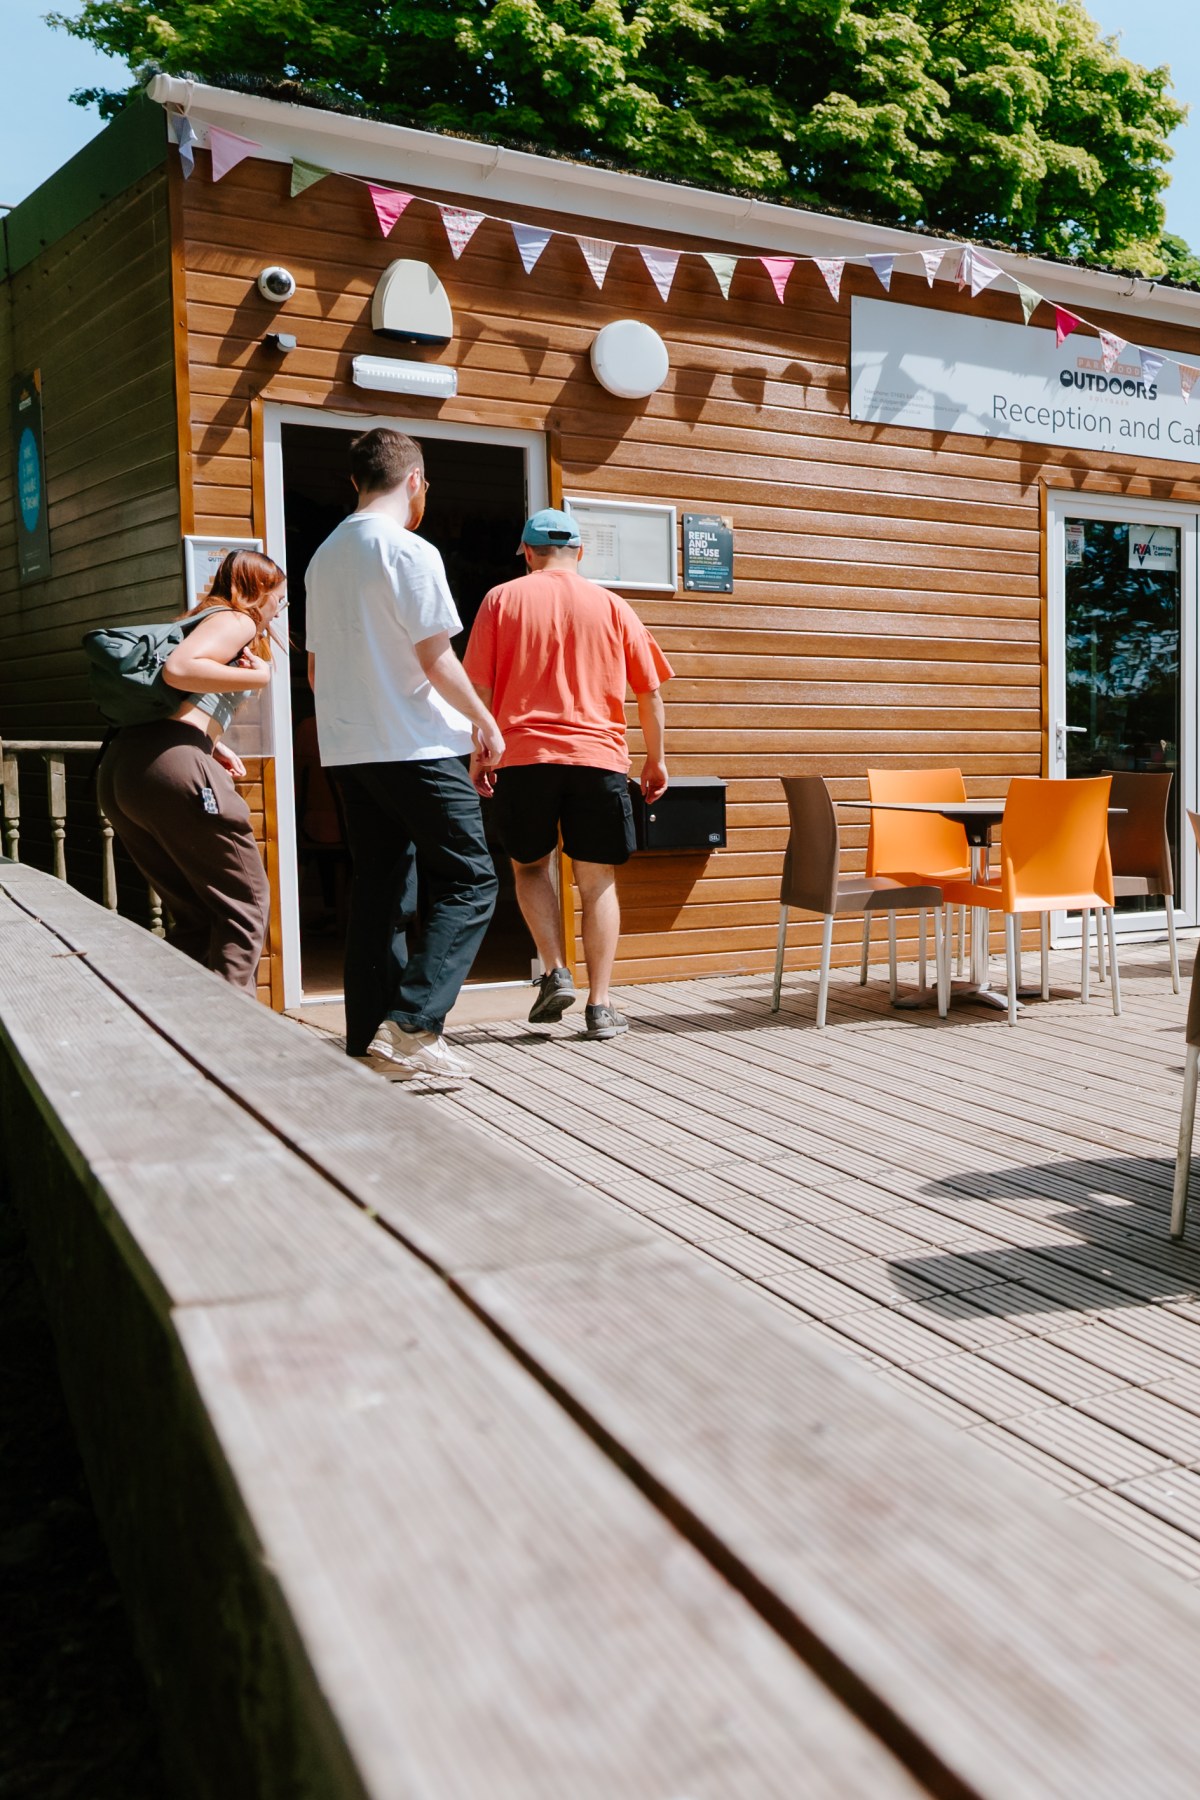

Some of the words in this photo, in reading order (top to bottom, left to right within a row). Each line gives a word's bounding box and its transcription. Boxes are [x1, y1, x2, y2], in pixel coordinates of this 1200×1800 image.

[1060, 370, 1158, 400] OUTDOORS
[993, 395, 1111, 433] Reception
[1119, 417, 1160, 440] and
[688, 531, 717, 541] REFILL
[688, 540, 708, 548] AND
[1133, 543, 1151, 556] RYA
[688, 548, 720, 557] RE-USE
